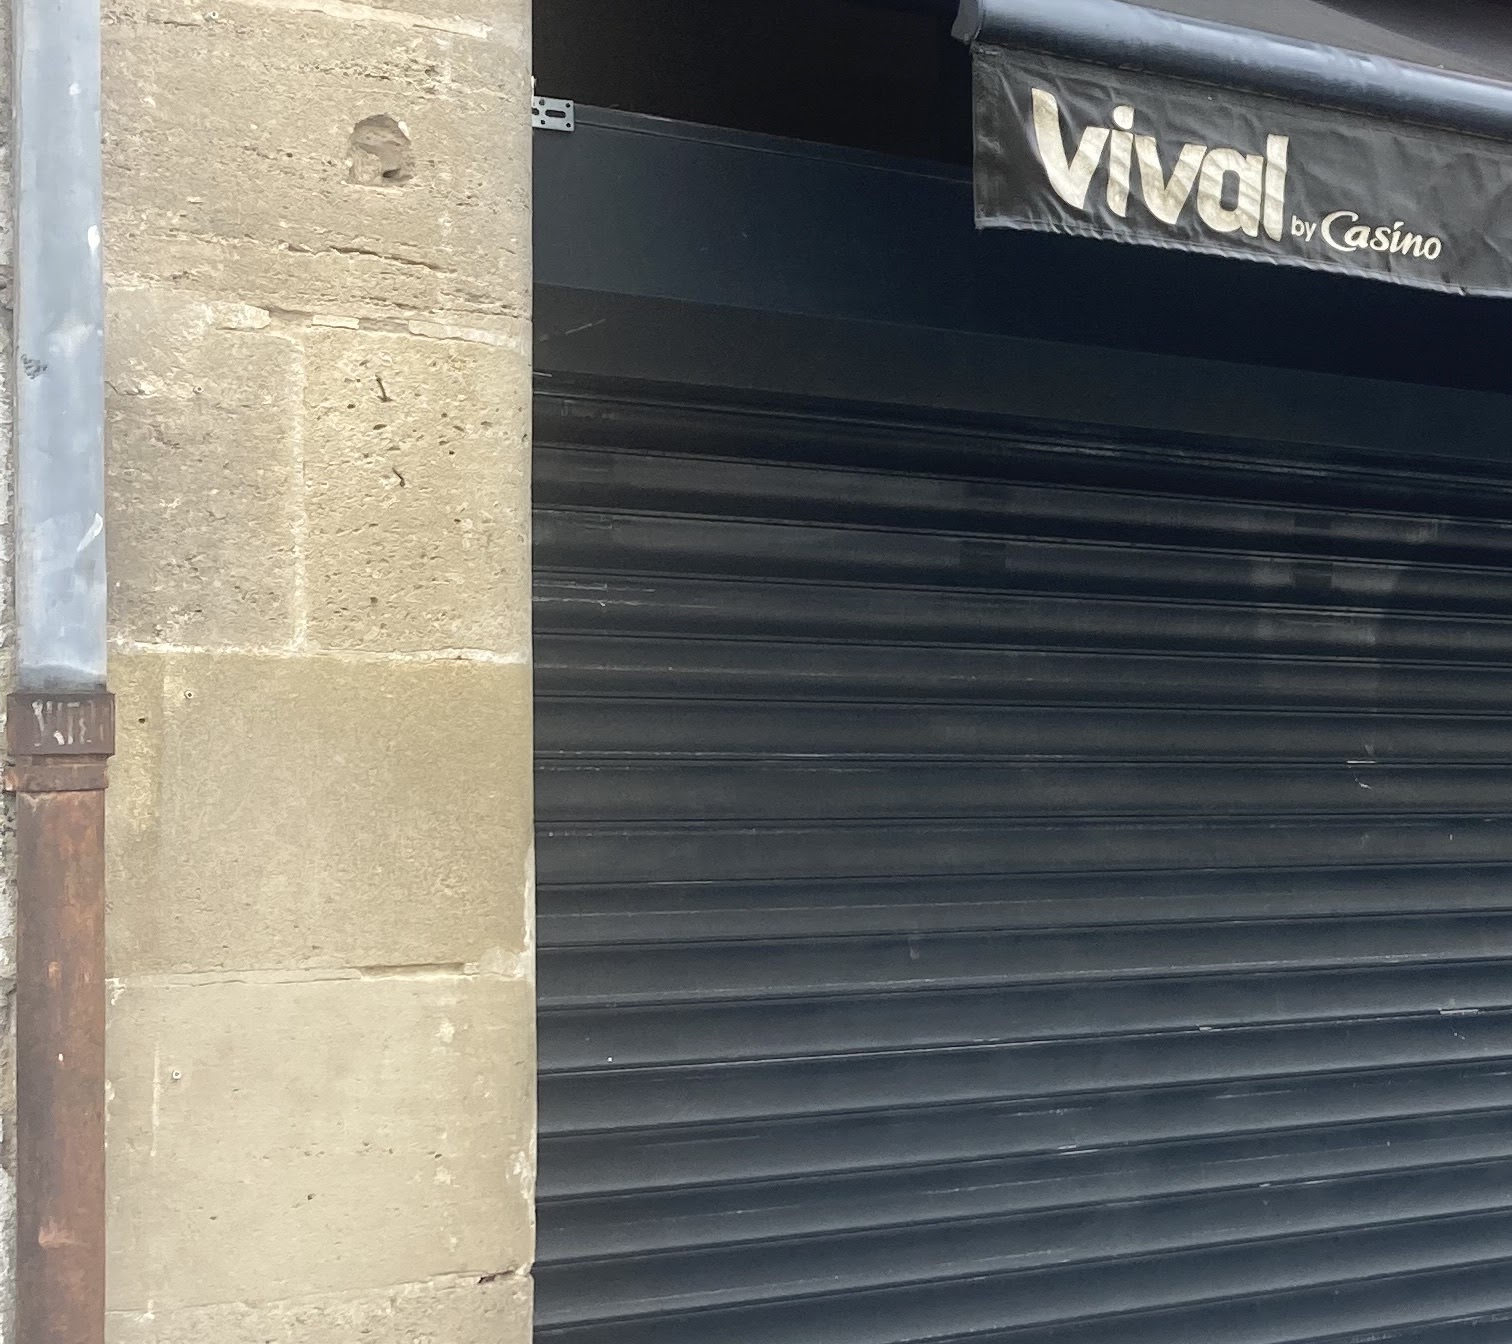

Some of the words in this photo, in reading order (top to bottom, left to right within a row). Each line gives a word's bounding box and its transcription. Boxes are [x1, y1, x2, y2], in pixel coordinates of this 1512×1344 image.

[1031, 87, 1289, 242] Vival
[1290, 214, 1317, 242] by
[1320, 210, 1442, 261] Casino
